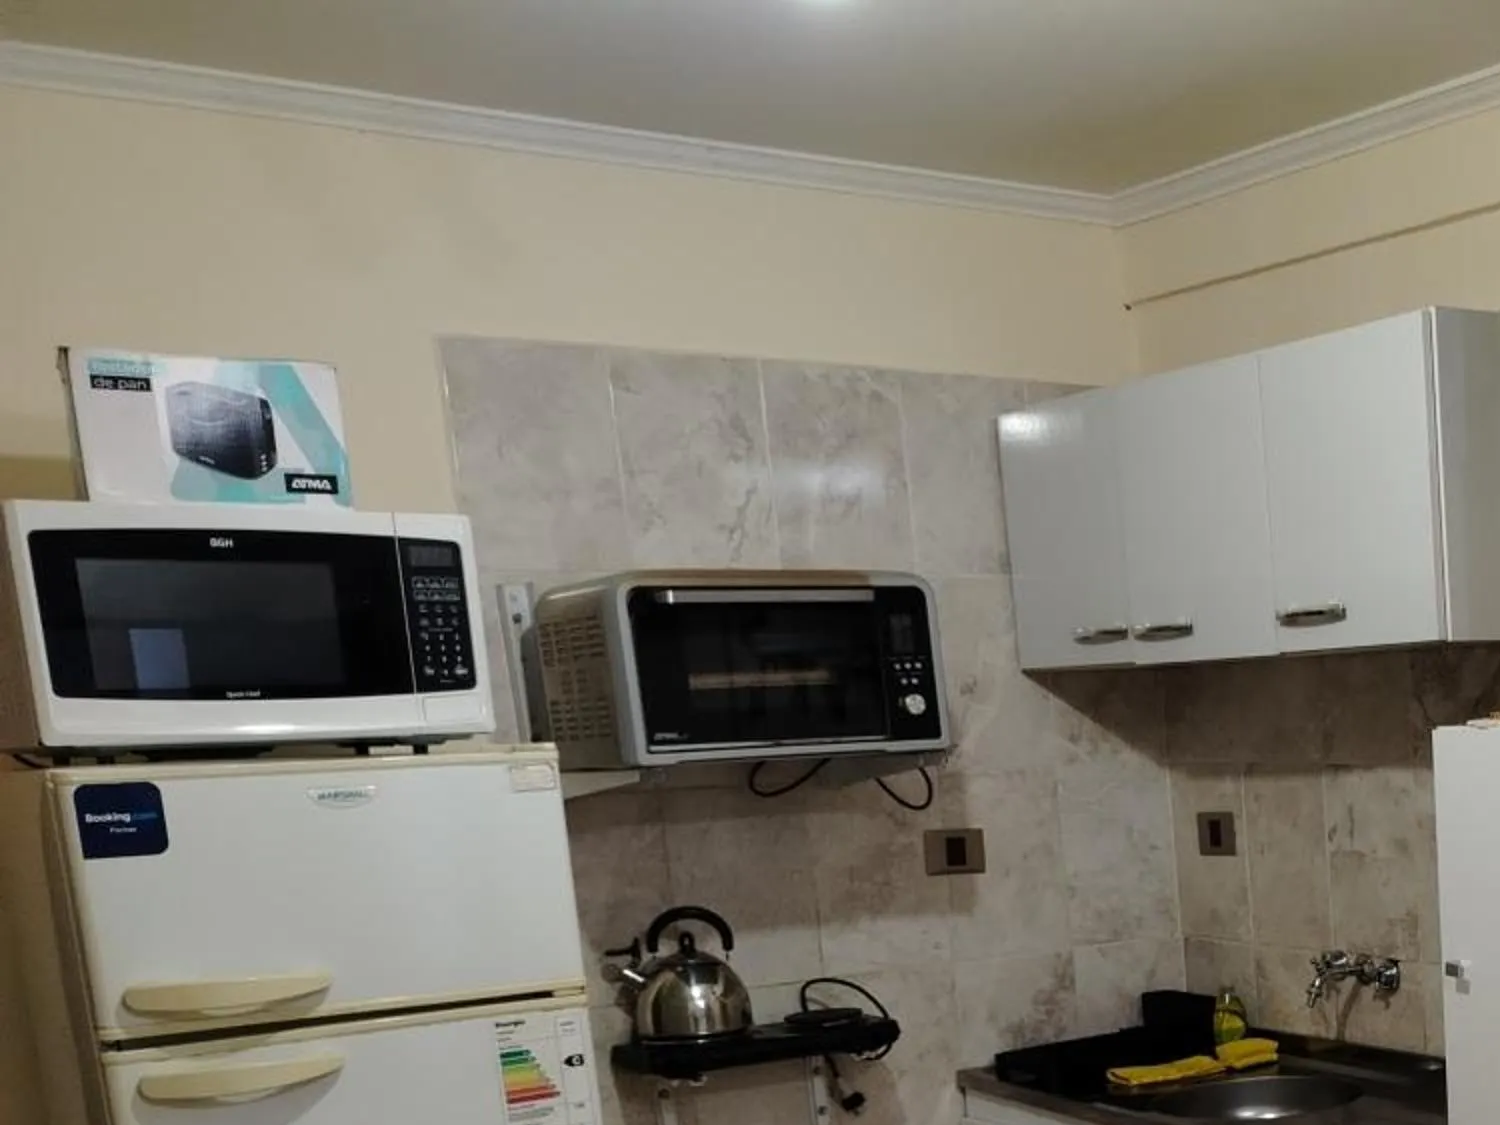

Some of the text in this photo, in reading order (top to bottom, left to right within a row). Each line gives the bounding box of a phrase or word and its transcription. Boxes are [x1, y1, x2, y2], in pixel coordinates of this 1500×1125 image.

[94, 377, 148, 391] de pan
[209, 536, 233, 548] BGH
